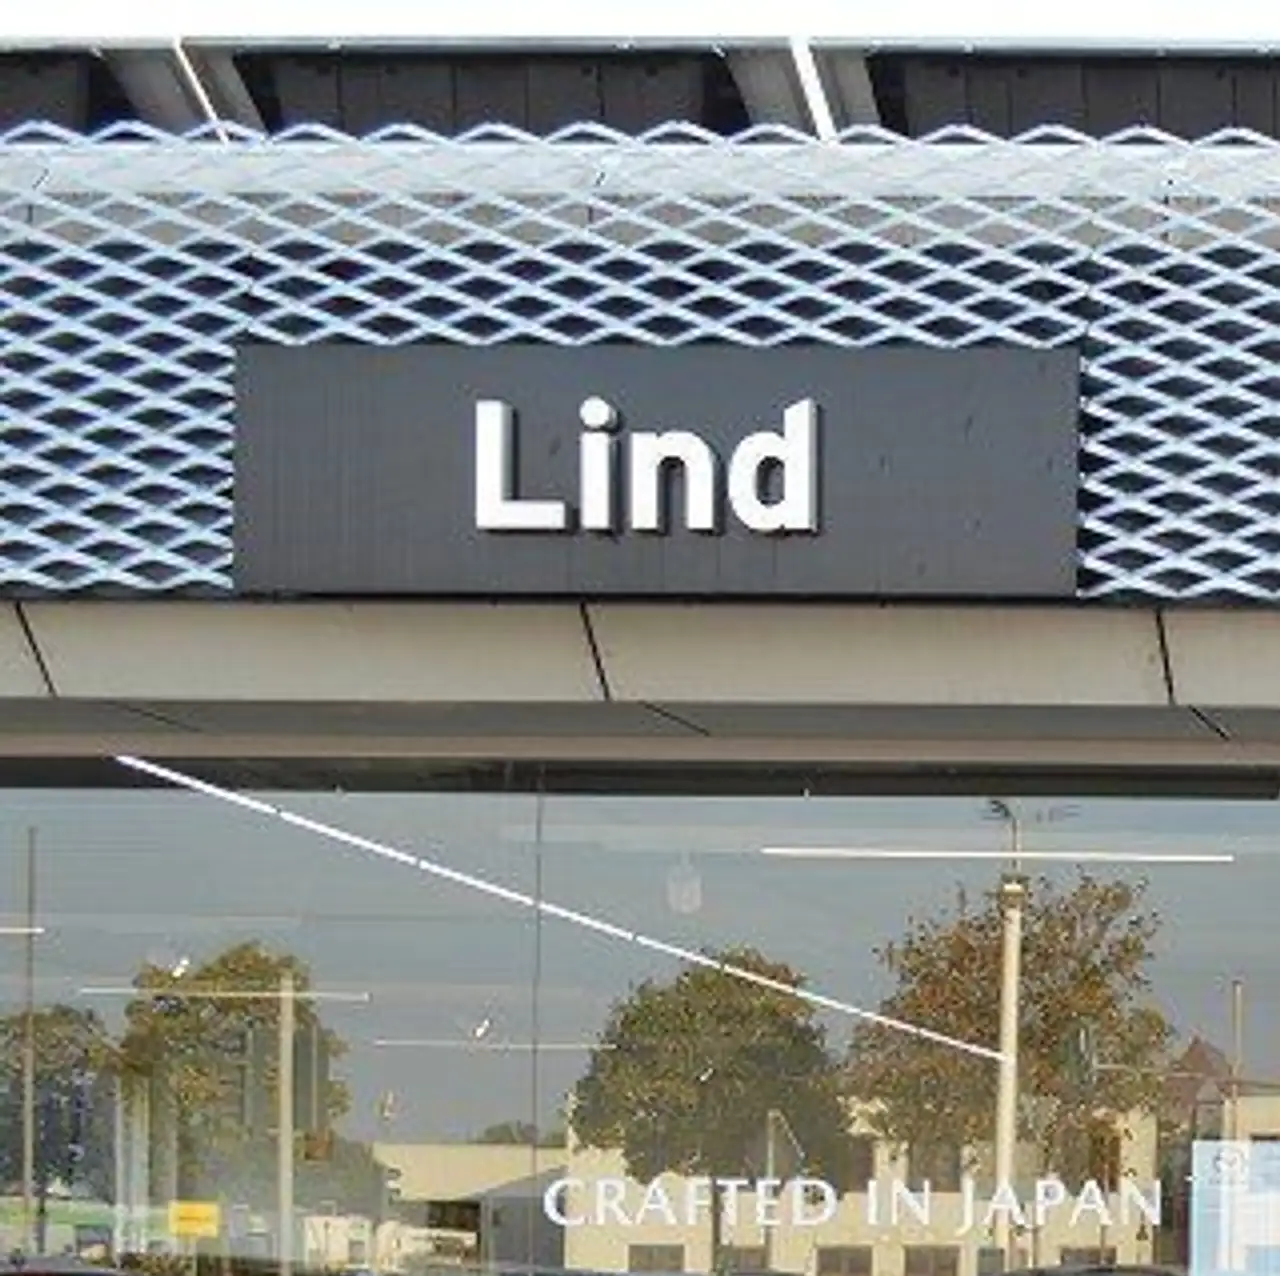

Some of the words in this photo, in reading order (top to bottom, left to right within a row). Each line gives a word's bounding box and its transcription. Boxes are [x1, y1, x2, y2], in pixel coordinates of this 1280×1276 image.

[476, 396, 820, 532] Lind
[542, 1177, 836, 1228] CRAFTED
[868, 1178, 931, 1226] IN
[953, 1179, 1164, 1235] JAPAN
